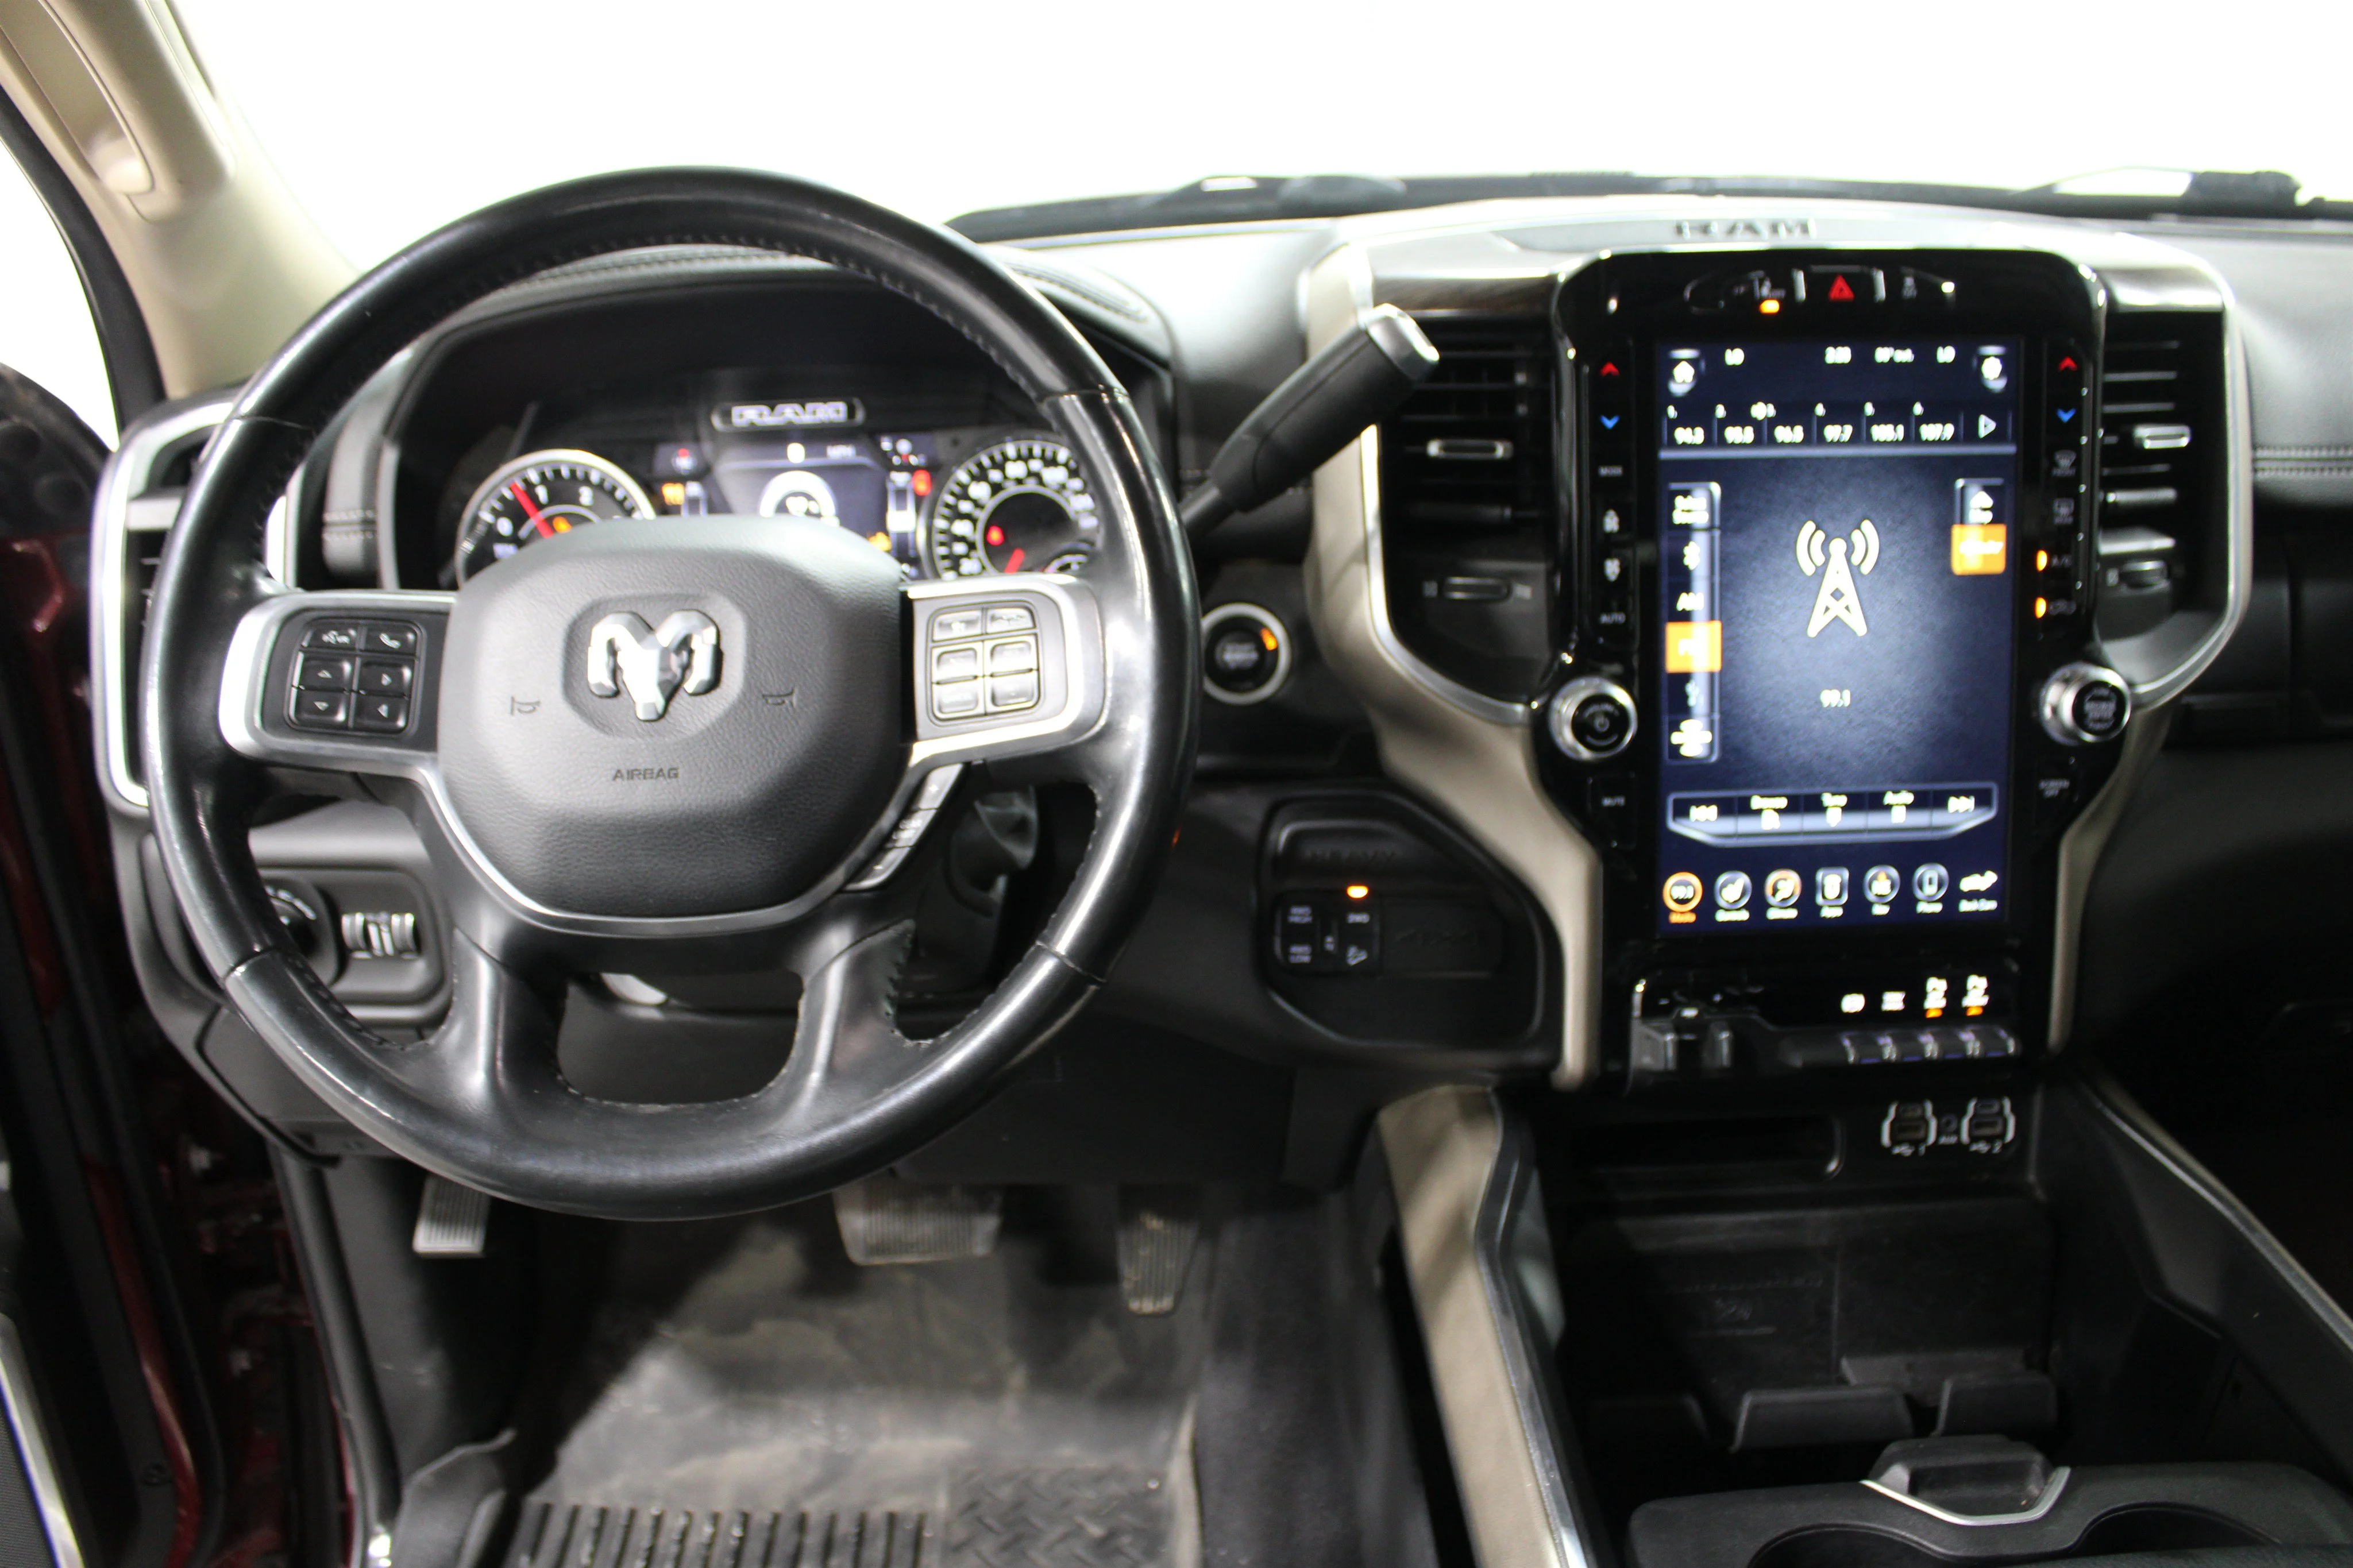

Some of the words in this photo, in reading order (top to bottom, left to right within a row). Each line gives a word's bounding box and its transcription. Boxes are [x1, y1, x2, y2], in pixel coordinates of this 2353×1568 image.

[731, 401, 848, 428] RAM
[534, 484, 549, 505] 1
[612, 768, 679, 781] AIRBAG
